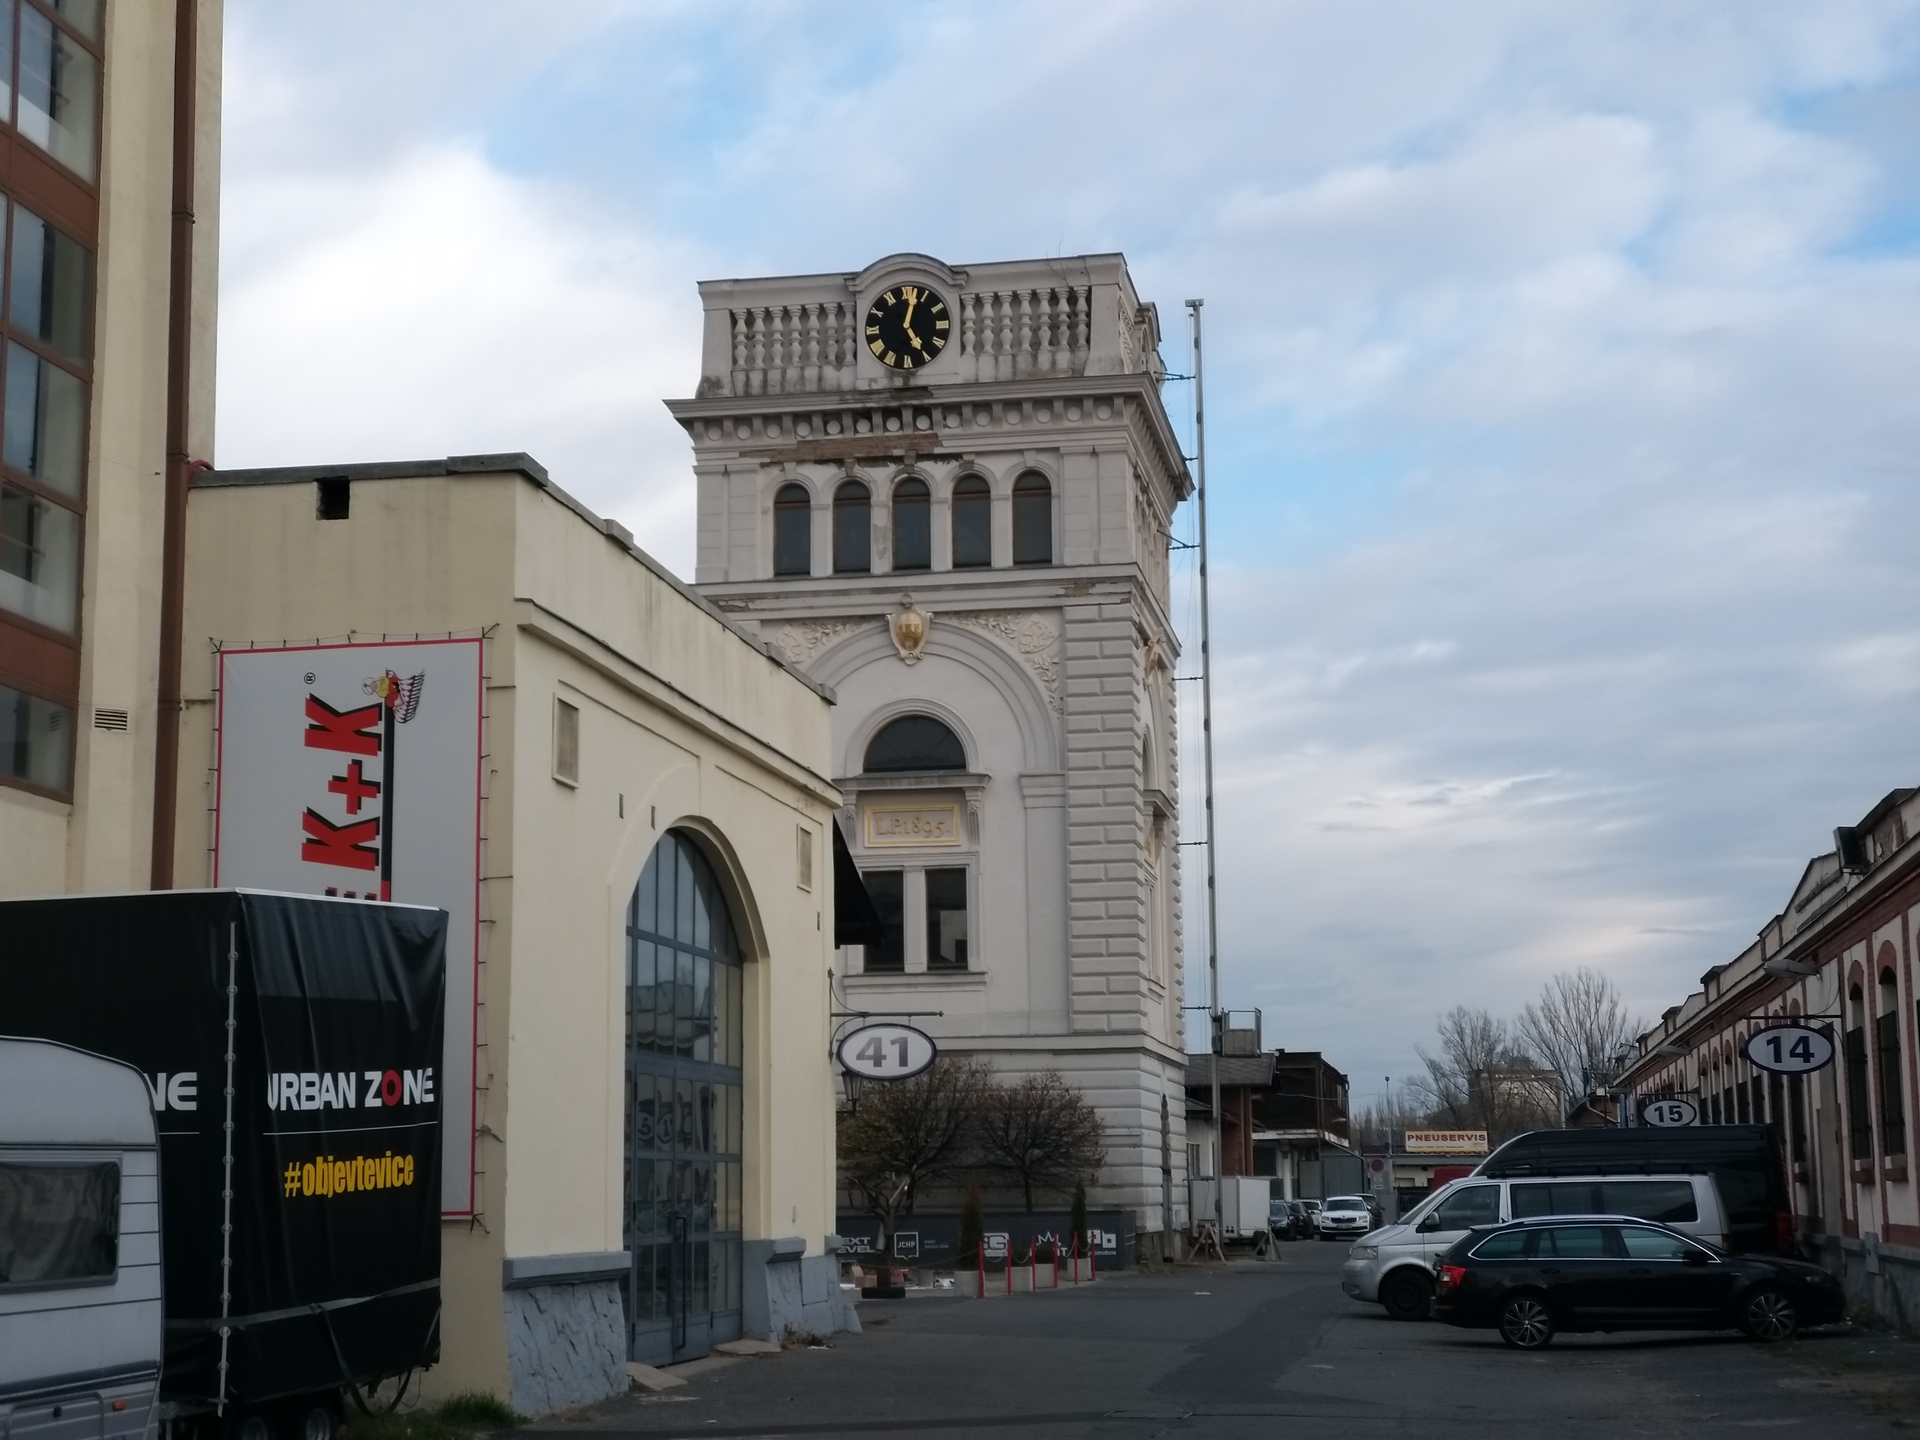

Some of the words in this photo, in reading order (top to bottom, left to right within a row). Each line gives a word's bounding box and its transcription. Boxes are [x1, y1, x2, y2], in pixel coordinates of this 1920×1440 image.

[855, 1036, 909, 1068] 41
[1766, 1035, 1815, 1063] 14
[267, 1071, 356, 1111] URBAN
[364, 1067, 435, 1108] ZONE
[1653, 1105, 1683, 1123] 15
[1407, 1133, 1486, 1142] PNEUSERVIS
[284, 1150, 415, 1198] #objevtevice
[897, 1240, 916, 1248] JCHP
